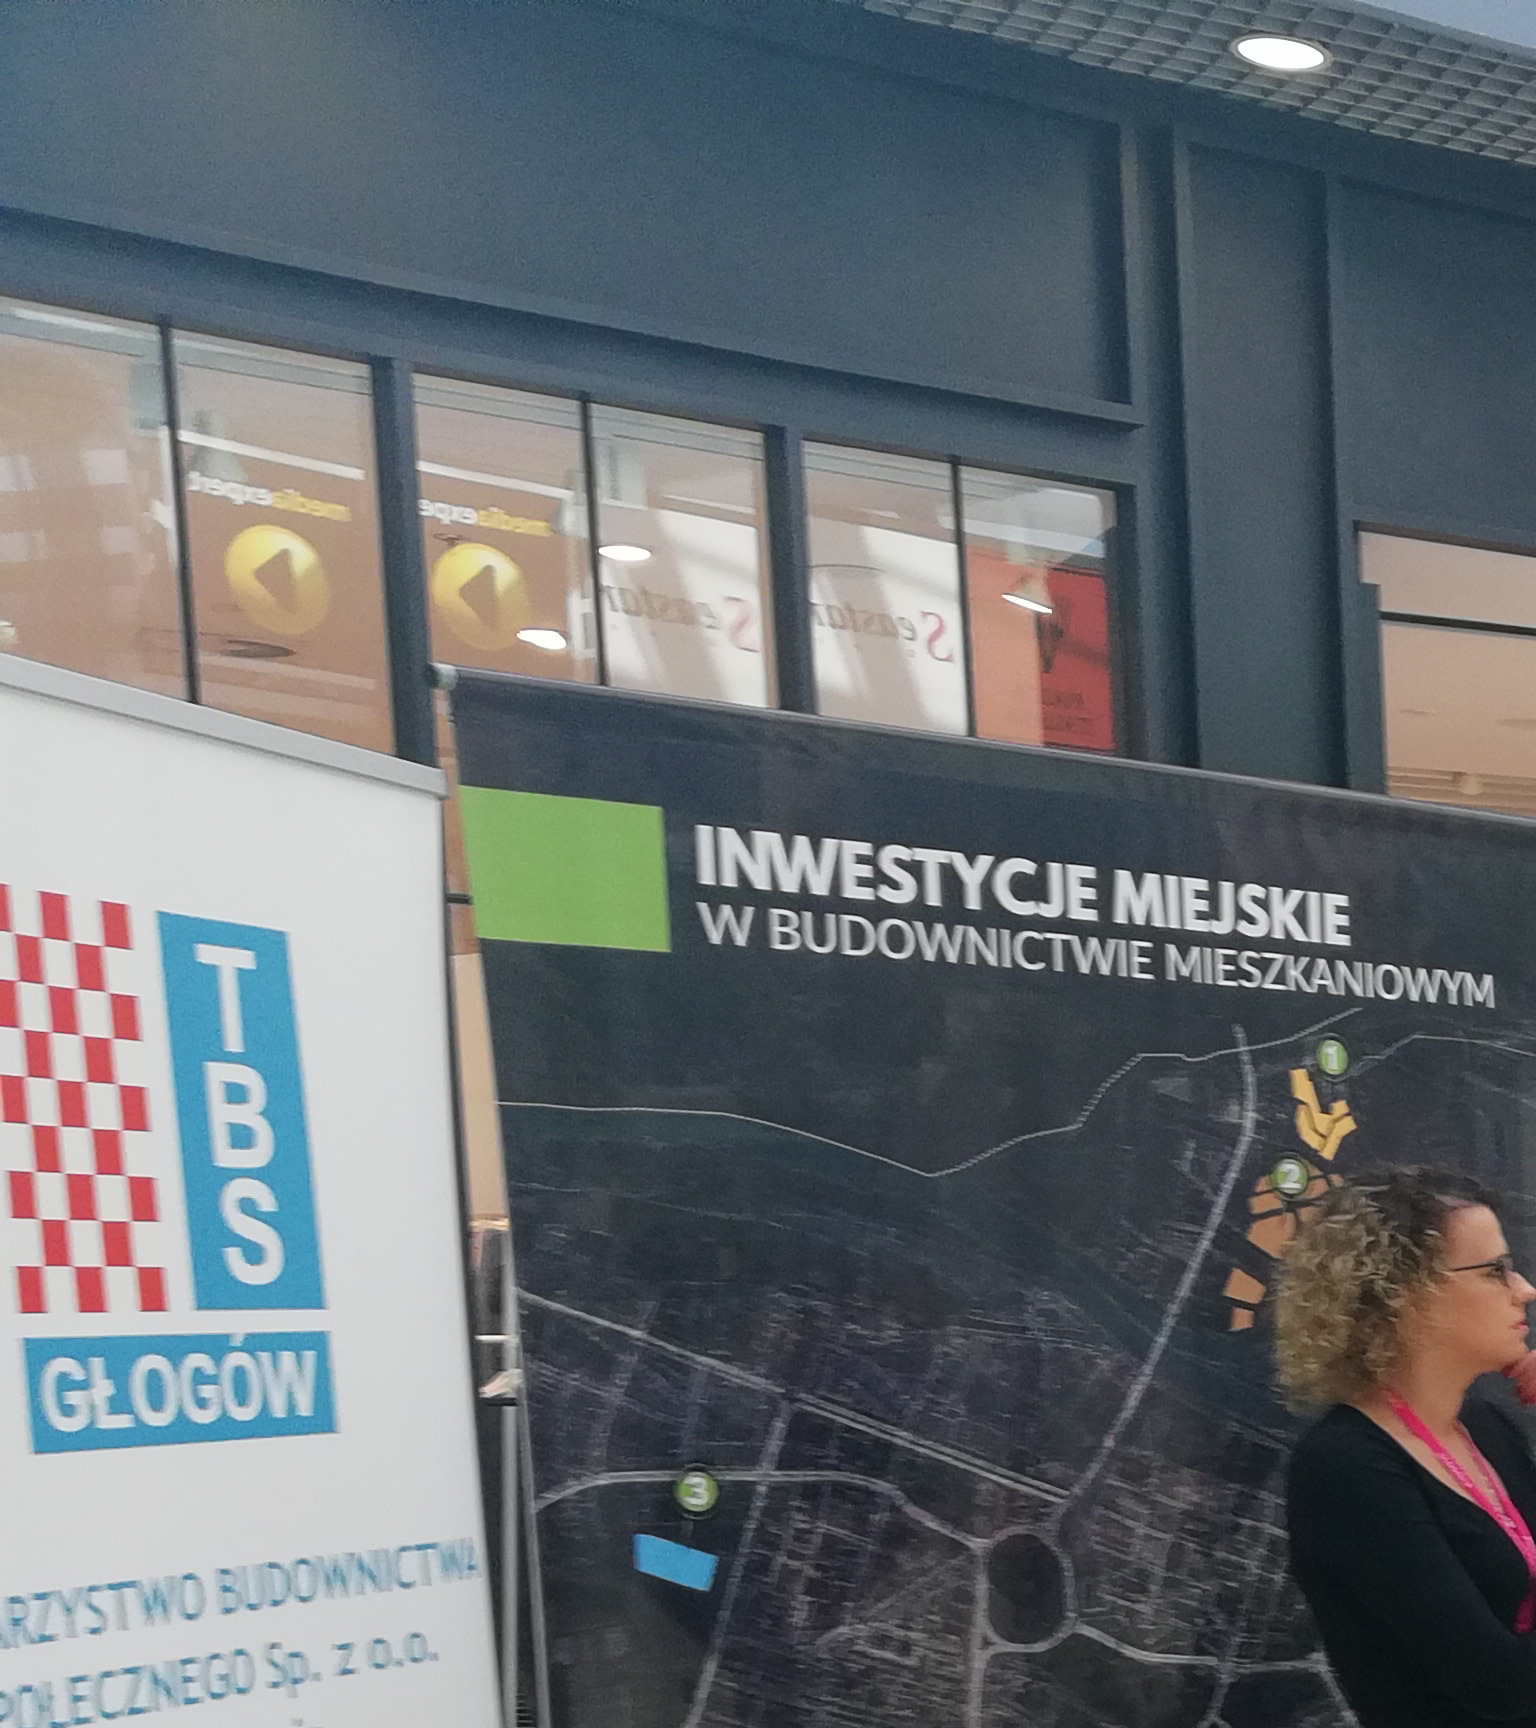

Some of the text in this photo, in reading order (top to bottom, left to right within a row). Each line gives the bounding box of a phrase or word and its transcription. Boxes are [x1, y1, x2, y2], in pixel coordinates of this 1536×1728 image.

[694, 823, 1352, 946] INWESTYCJE MIEJSKIE
[696, 902, 1496, 1009] W BUDOWNICTWIE MIESZKANIOWYM
[1327, 1045, 1339, 1070] 1
[194, 943, 287, 1286] TBS
[1279, 1164, 1300, 1191] 2
[39, 1332, 319, 1432] GŁOGÓW
[683, 1476, 710, 1506] 3
[264, 1641, 323, 1698] Sp.
[331, 1641, 360, 1677] z
